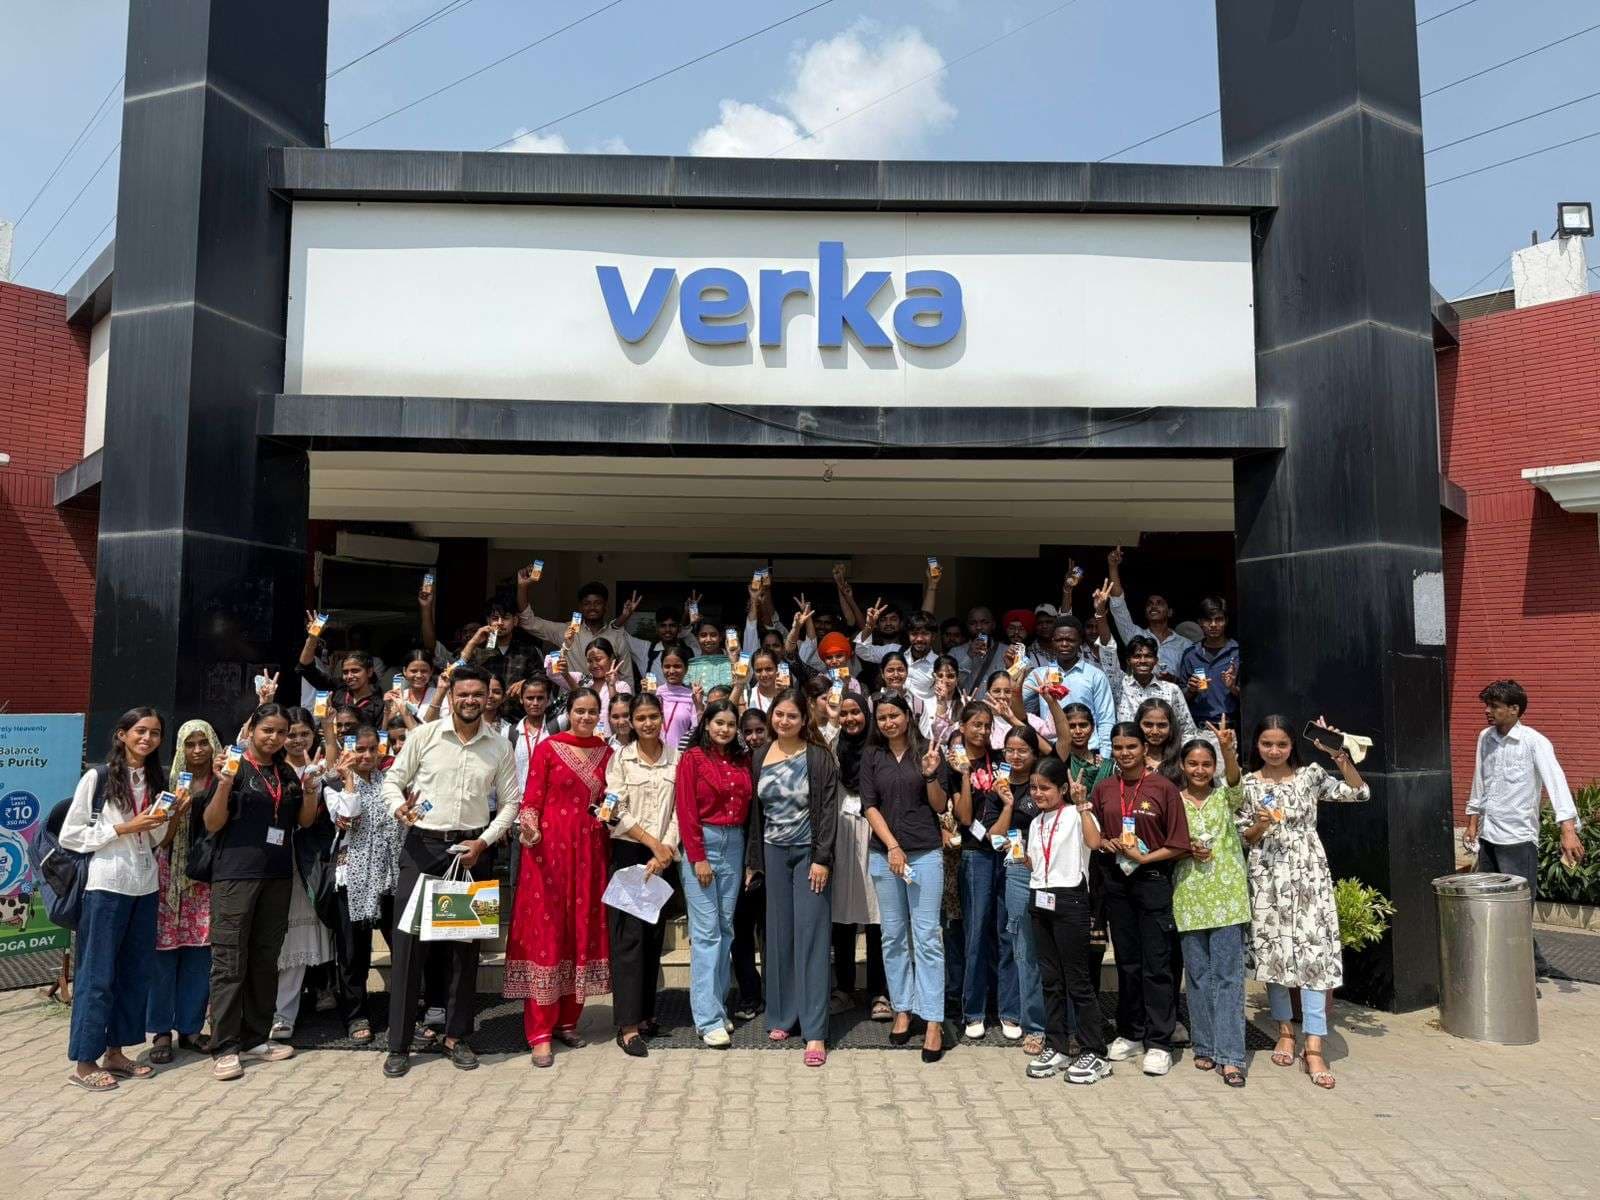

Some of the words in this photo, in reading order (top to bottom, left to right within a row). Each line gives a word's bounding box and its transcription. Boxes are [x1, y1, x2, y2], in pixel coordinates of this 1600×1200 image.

[595, 241, 963, 349] verka
[8, 756, 49, 768] Purity
[0, 940, 26, 952] OGA
[29, 935, 56, 948] DAY
